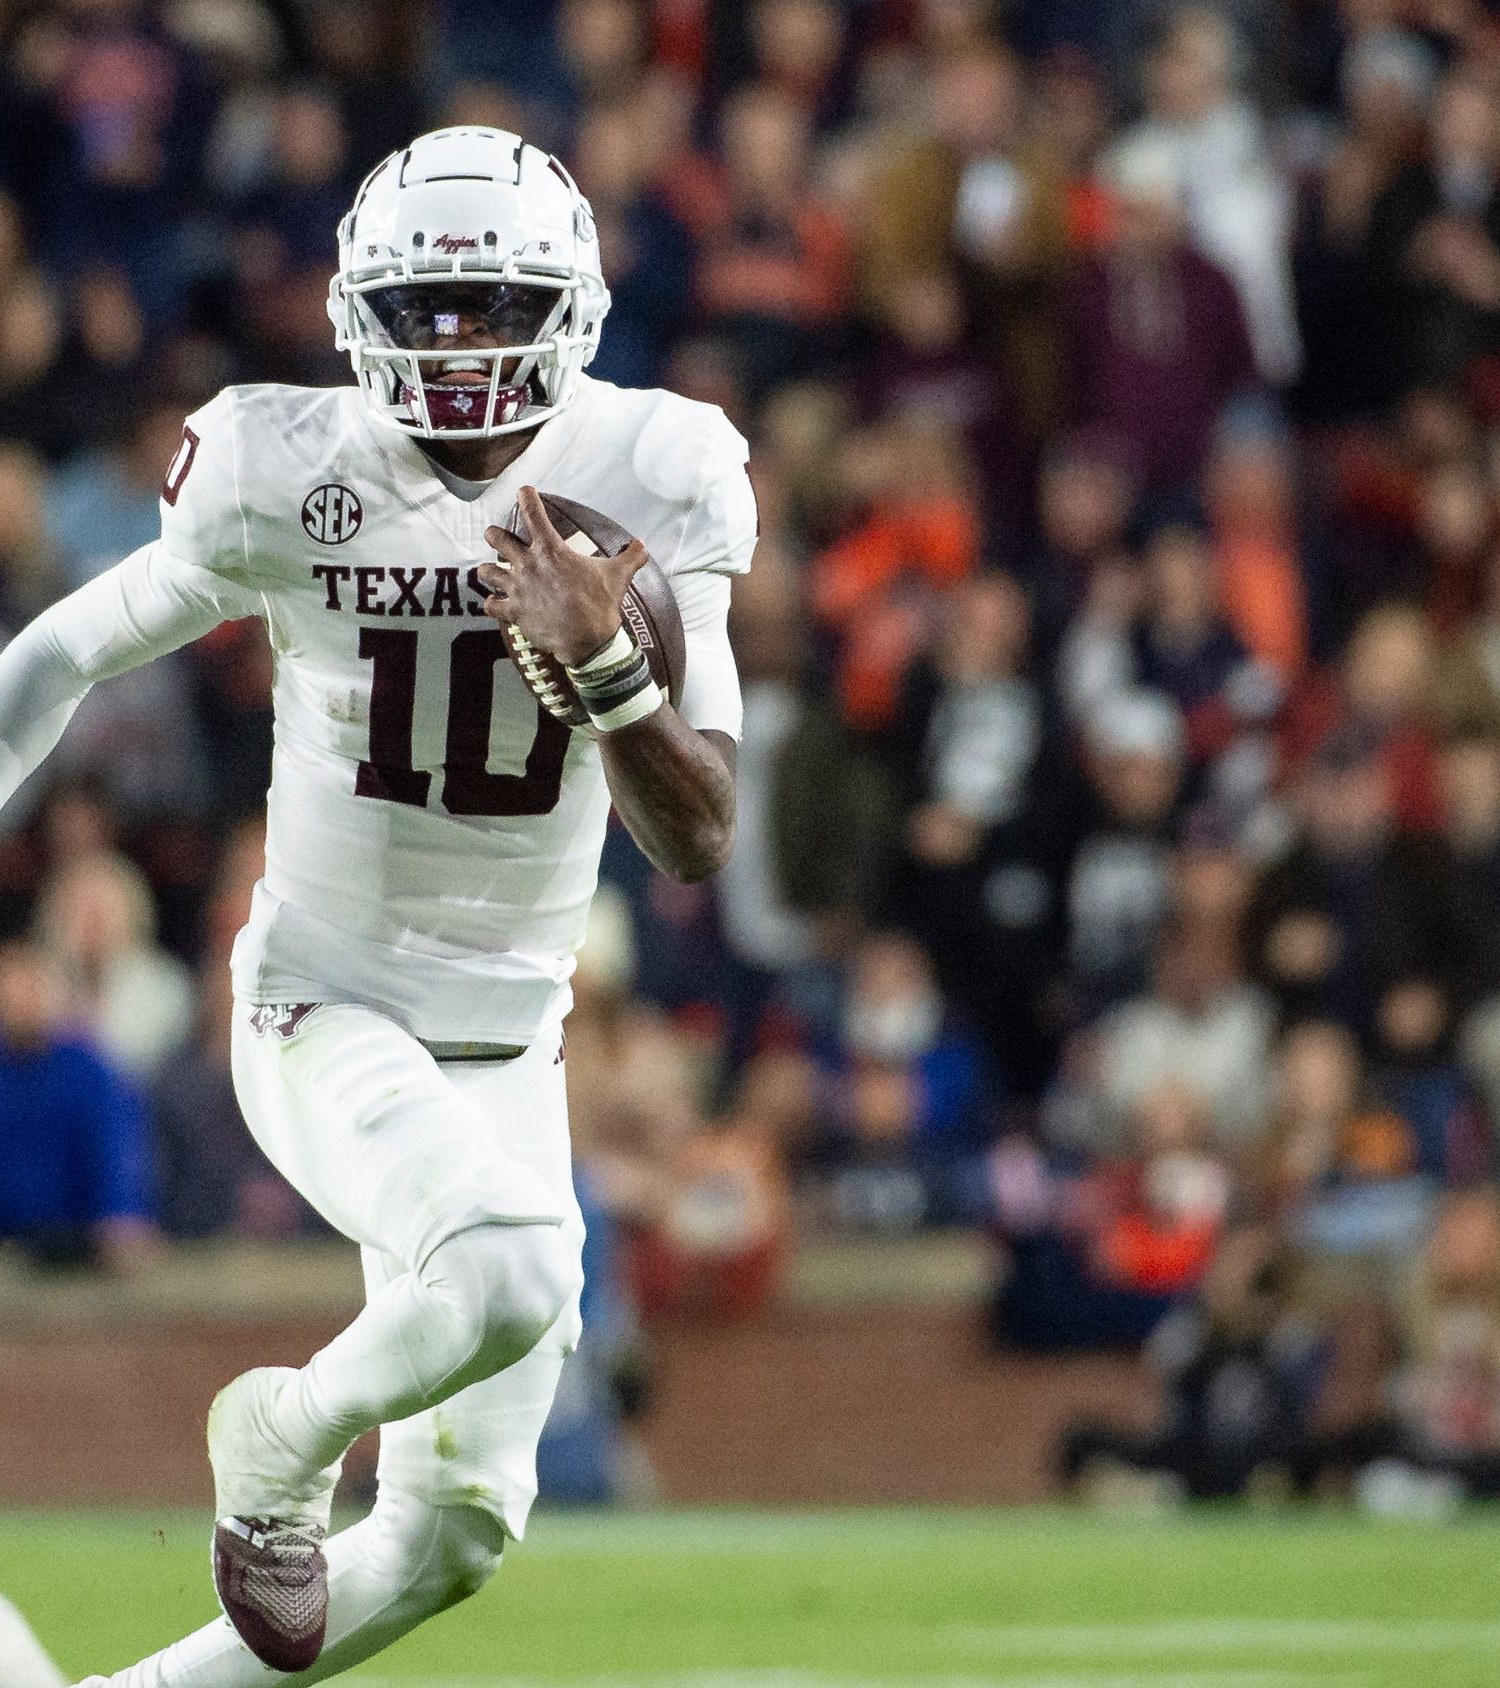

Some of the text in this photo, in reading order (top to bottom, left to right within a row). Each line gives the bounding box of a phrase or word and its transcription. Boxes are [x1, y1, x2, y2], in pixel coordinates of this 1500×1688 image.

[432, 234, 477, 255] Aggies
[304, 485, 359, 543] SEC
[311, 564, 490, 617] TEXAS
[354, 626, 574, 817] 10
